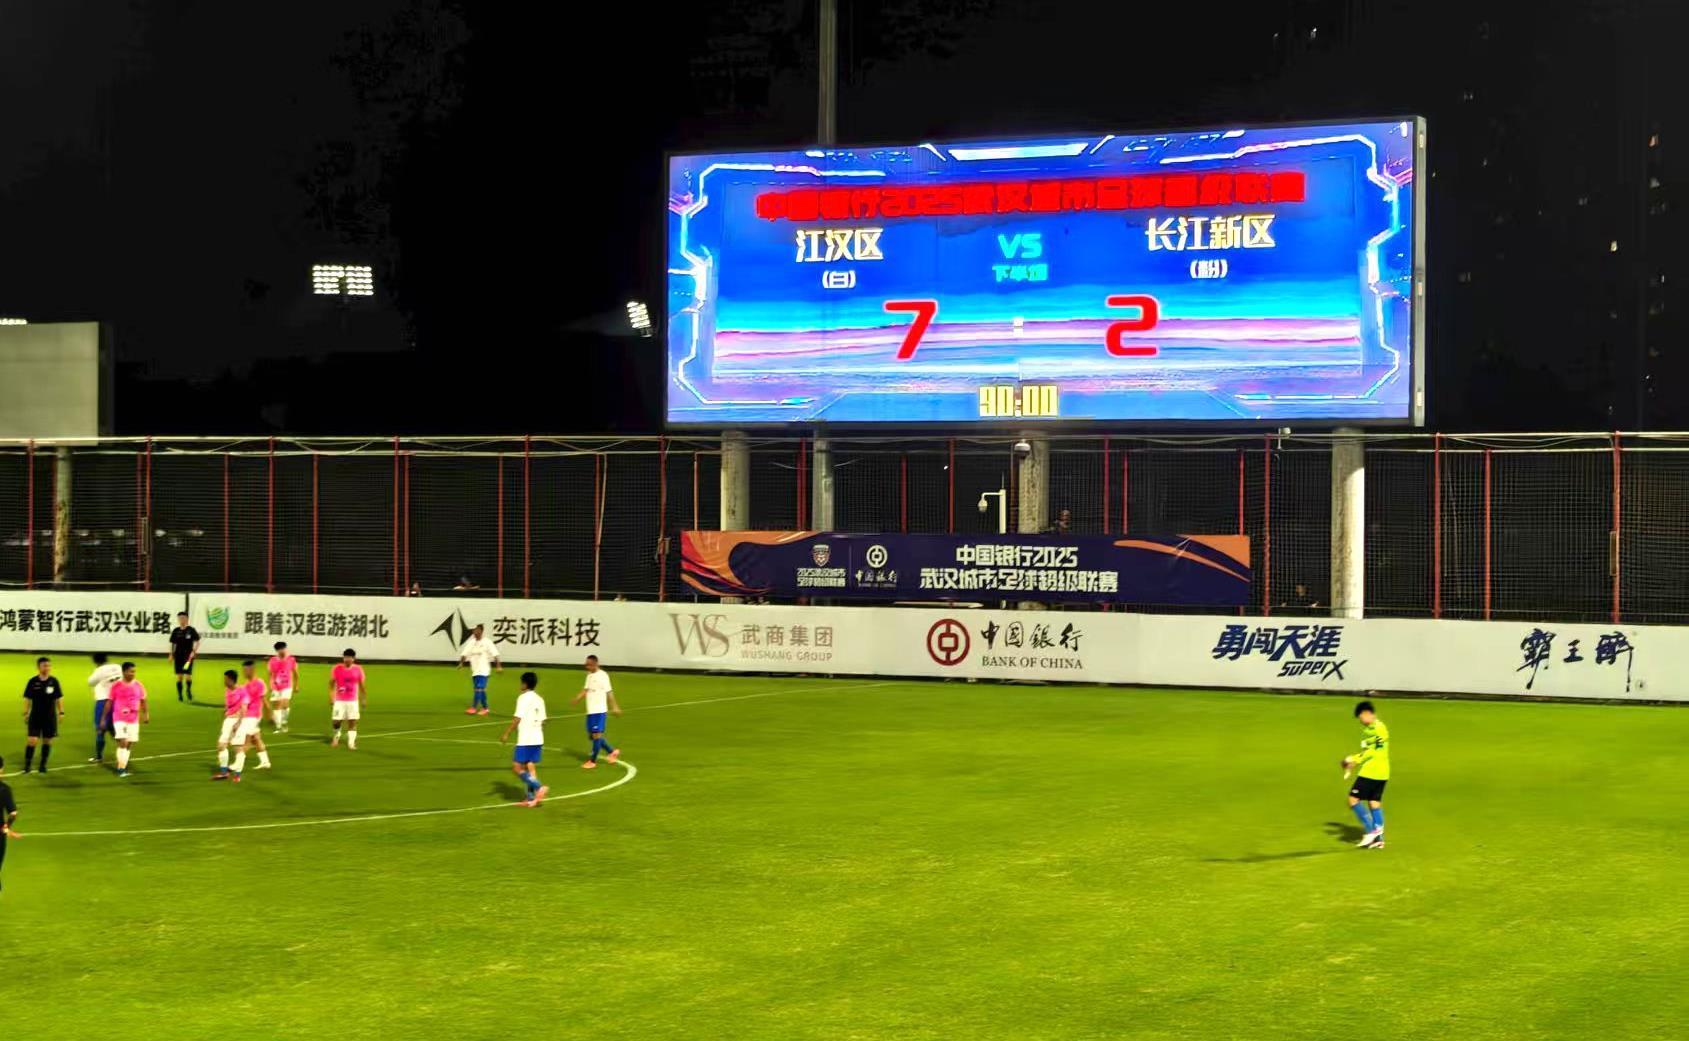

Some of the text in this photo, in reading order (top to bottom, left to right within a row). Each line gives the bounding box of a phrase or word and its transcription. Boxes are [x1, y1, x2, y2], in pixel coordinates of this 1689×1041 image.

[796, 228, 884, 262] 江汉区
[997, 233, 1043, 259] VS
[1145, 214, 1276, 251] 长江新区
[884, 299, 938, 360] 7
[1105, 295, 1160, 357] 2
[979, 385, 1058, 417] 90:00
[956, 544, 1079, 568] 中国银行2025
[919, 567, 1119, 593] 武汉城市足球超级联赛
[0, 609, 171, 634] 鸿蒙智行武汉兴业路
[244, 612, 389, 638] 跟着汉超游湖北
[493, 616, 600, 646] 奕派科技
[668, 613, 731, 657] WS
[742, 623, 833, 648] 武商集团
[742, 650, 833, 662] WUSHANG GROUP
[1212, 624, 1344, 661] 勇闯天涯
[982, 655, 1083, 669] BANK OF CHINA
[1516, 628, 1634, 692] 霸王醉
